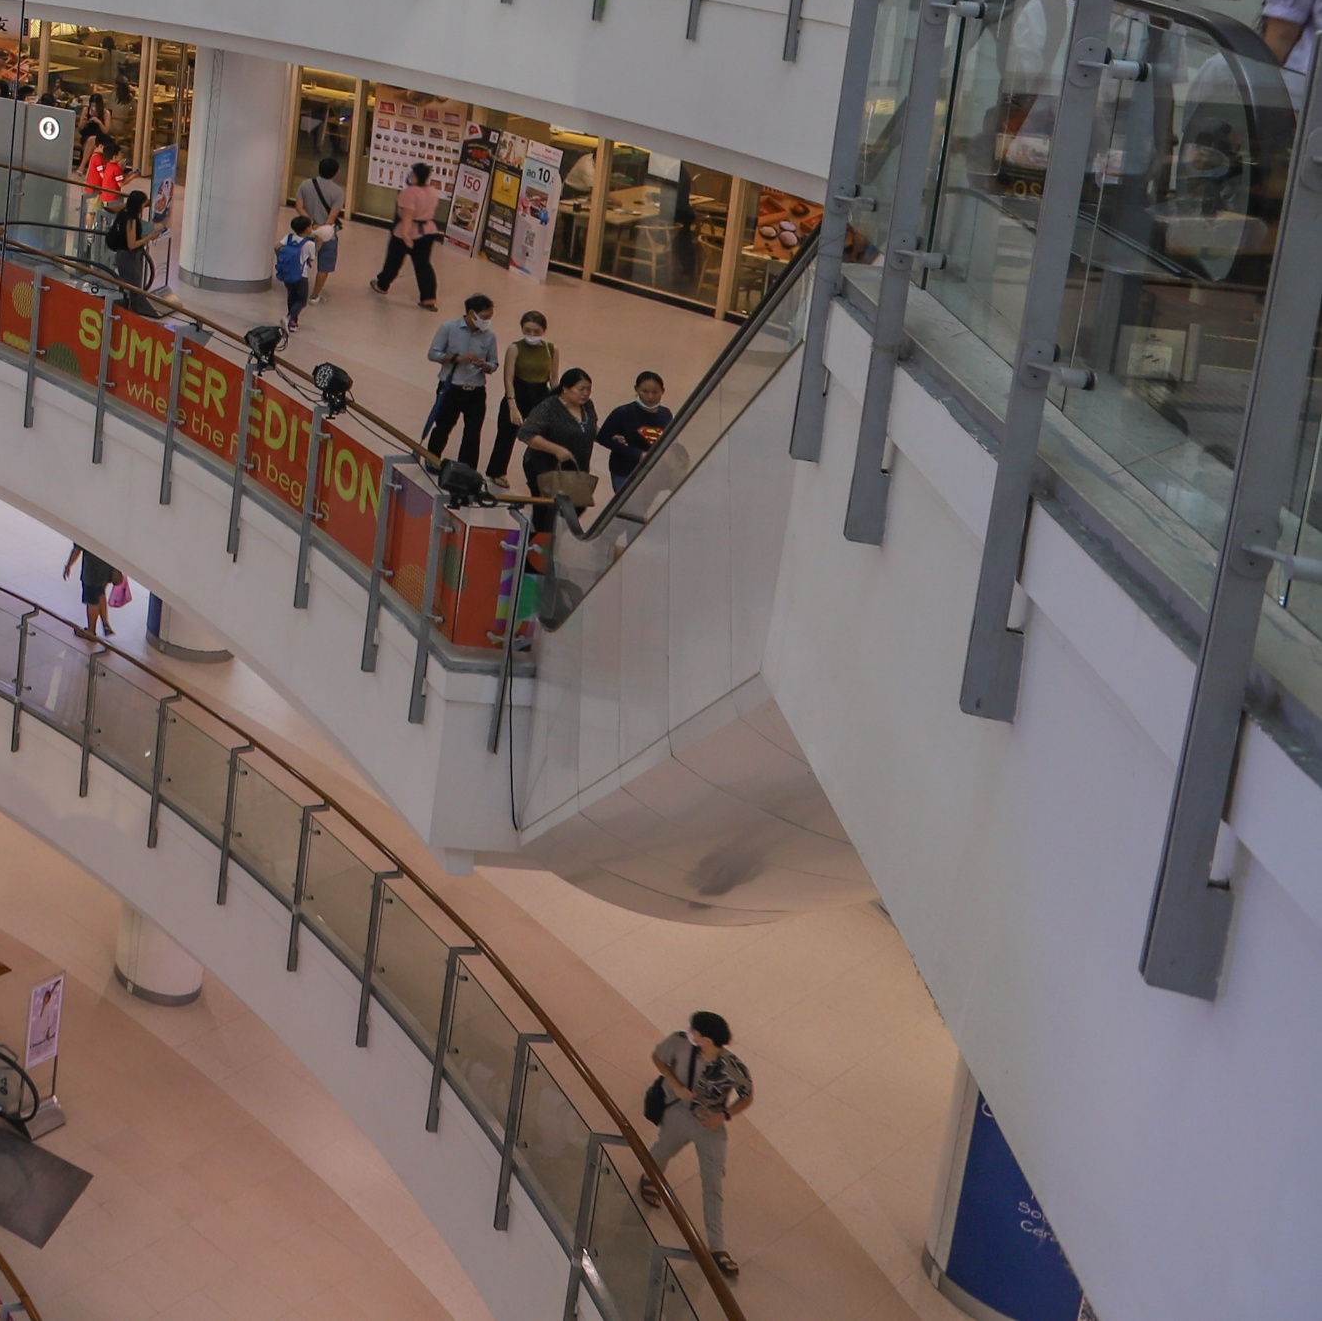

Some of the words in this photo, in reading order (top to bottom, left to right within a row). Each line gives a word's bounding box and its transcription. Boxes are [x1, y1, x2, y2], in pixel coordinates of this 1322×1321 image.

[463, 174, 481, 192] 150
[126, 380, 187, 423] whee
[191, 410, 225, 450] the
[229, 431, 262, 473] fn
